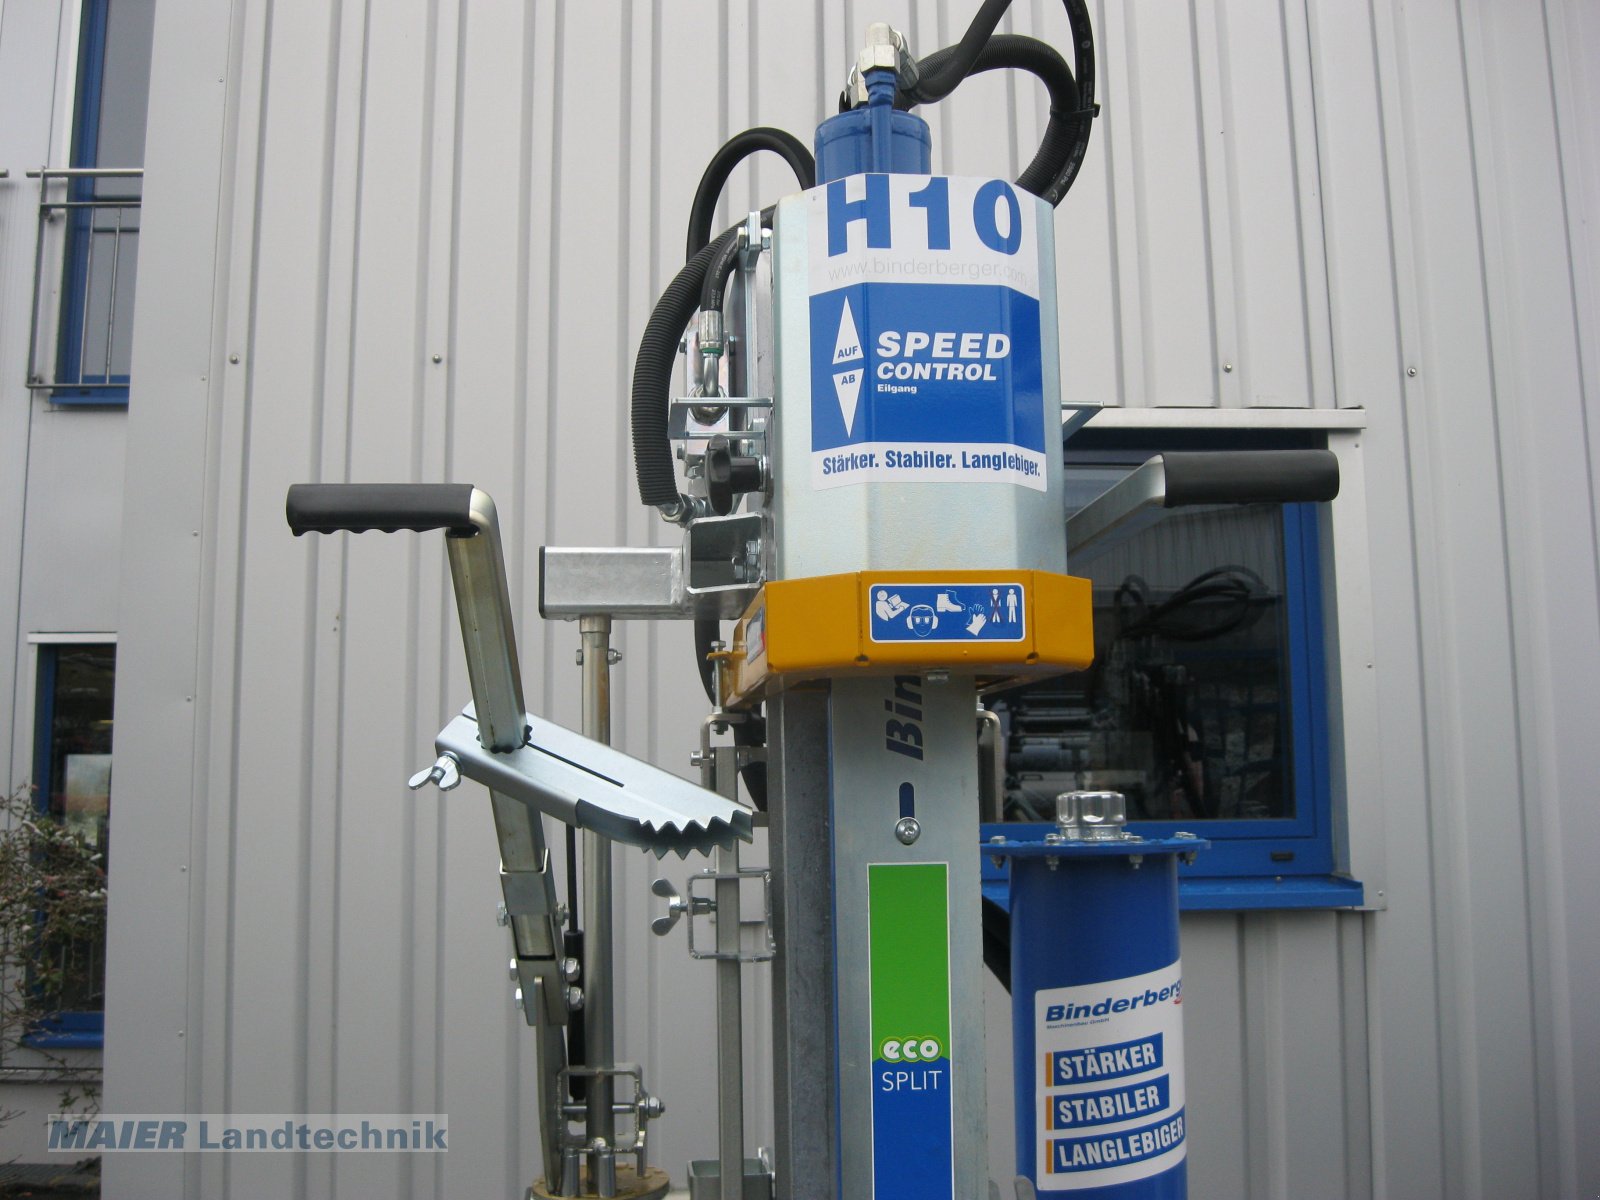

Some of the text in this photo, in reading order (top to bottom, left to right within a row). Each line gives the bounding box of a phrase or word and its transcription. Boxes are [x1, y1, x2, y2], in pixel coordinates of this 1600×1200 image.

[826, 173, 1022, 257] H10
[828, 257, 1028, 285] www.binderberger.com
[837, 346, 858, 359] AUF
[876, 331, 1011, 359] SPEED
[841, 373, 856, 386] AB
[876, 362, 997, 381] CONTROL
[877, 384, 917, 394] Eilgang
[823, 450, 1041, 477] Stärker. Stabiler. Langlebiger.
[883, 1039, 939, 1060] eco
[1058, 1042, 1156, 1080] STÄRKER
[882, 1070, 943, 1091] SPLIT
[1058, 1085, 1160, 1123] STABILER
[1058, 1115, 1184, 1167] LANGLEBIGER
